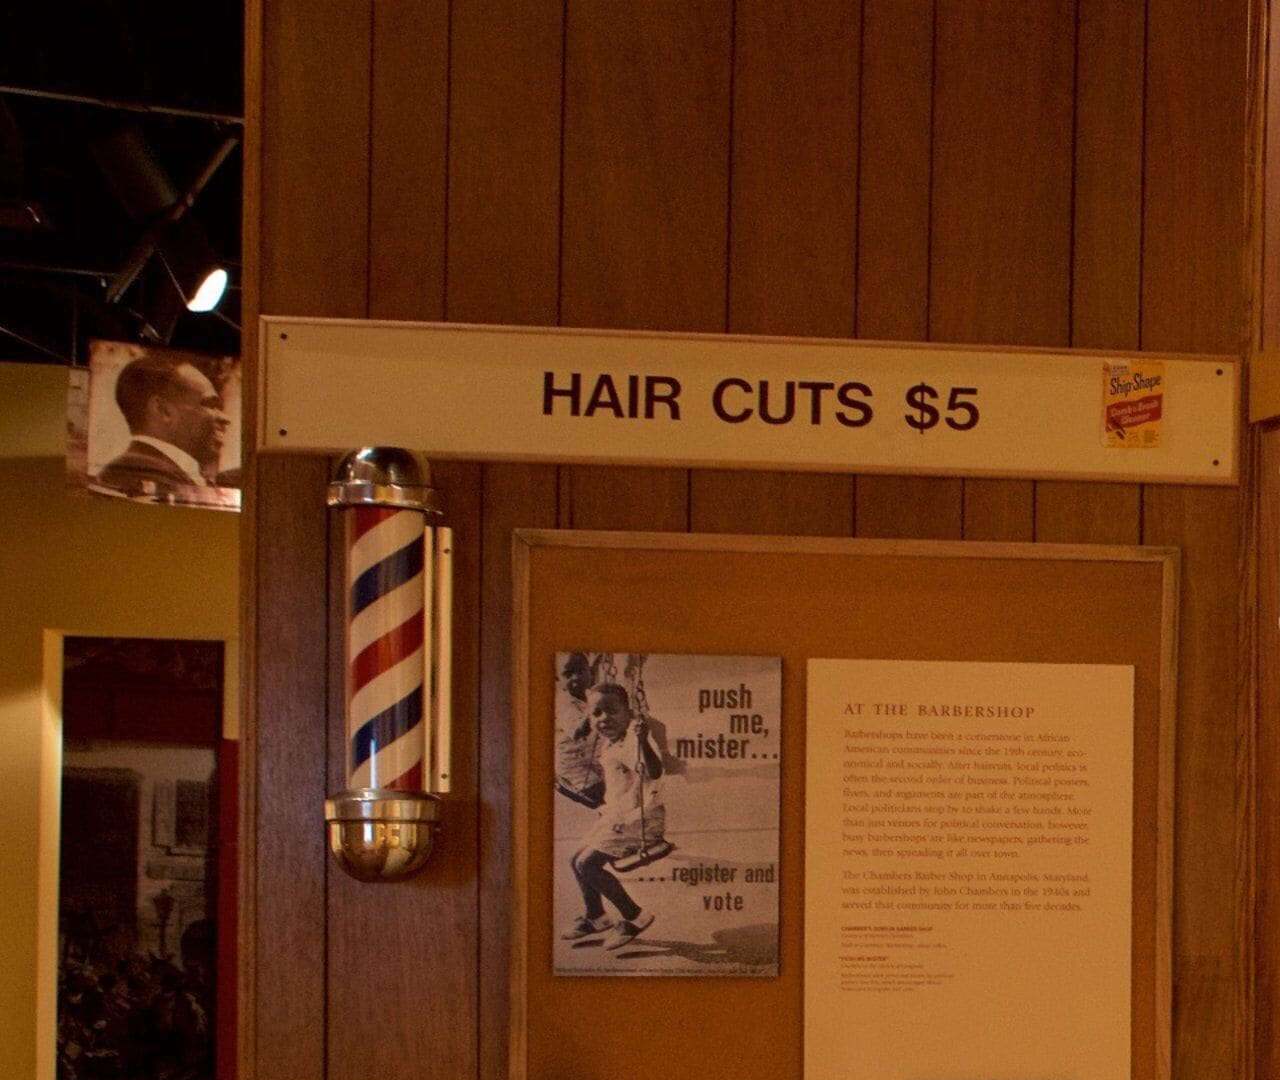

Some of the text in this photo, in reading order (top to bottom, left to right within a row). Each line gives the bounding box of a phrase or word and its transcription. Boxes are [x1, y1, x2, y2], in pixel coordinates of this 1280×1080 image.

[543, 371, 981, 434] HAIR CUTS $5
[698, 684, 753, 712] push
[843, 703, 1035, 719] AT THE BARBERSHOP
[729, 710, 770, 739] me,
[744, 862, 775, 884] and
[703, 892, 744, 912] vote
